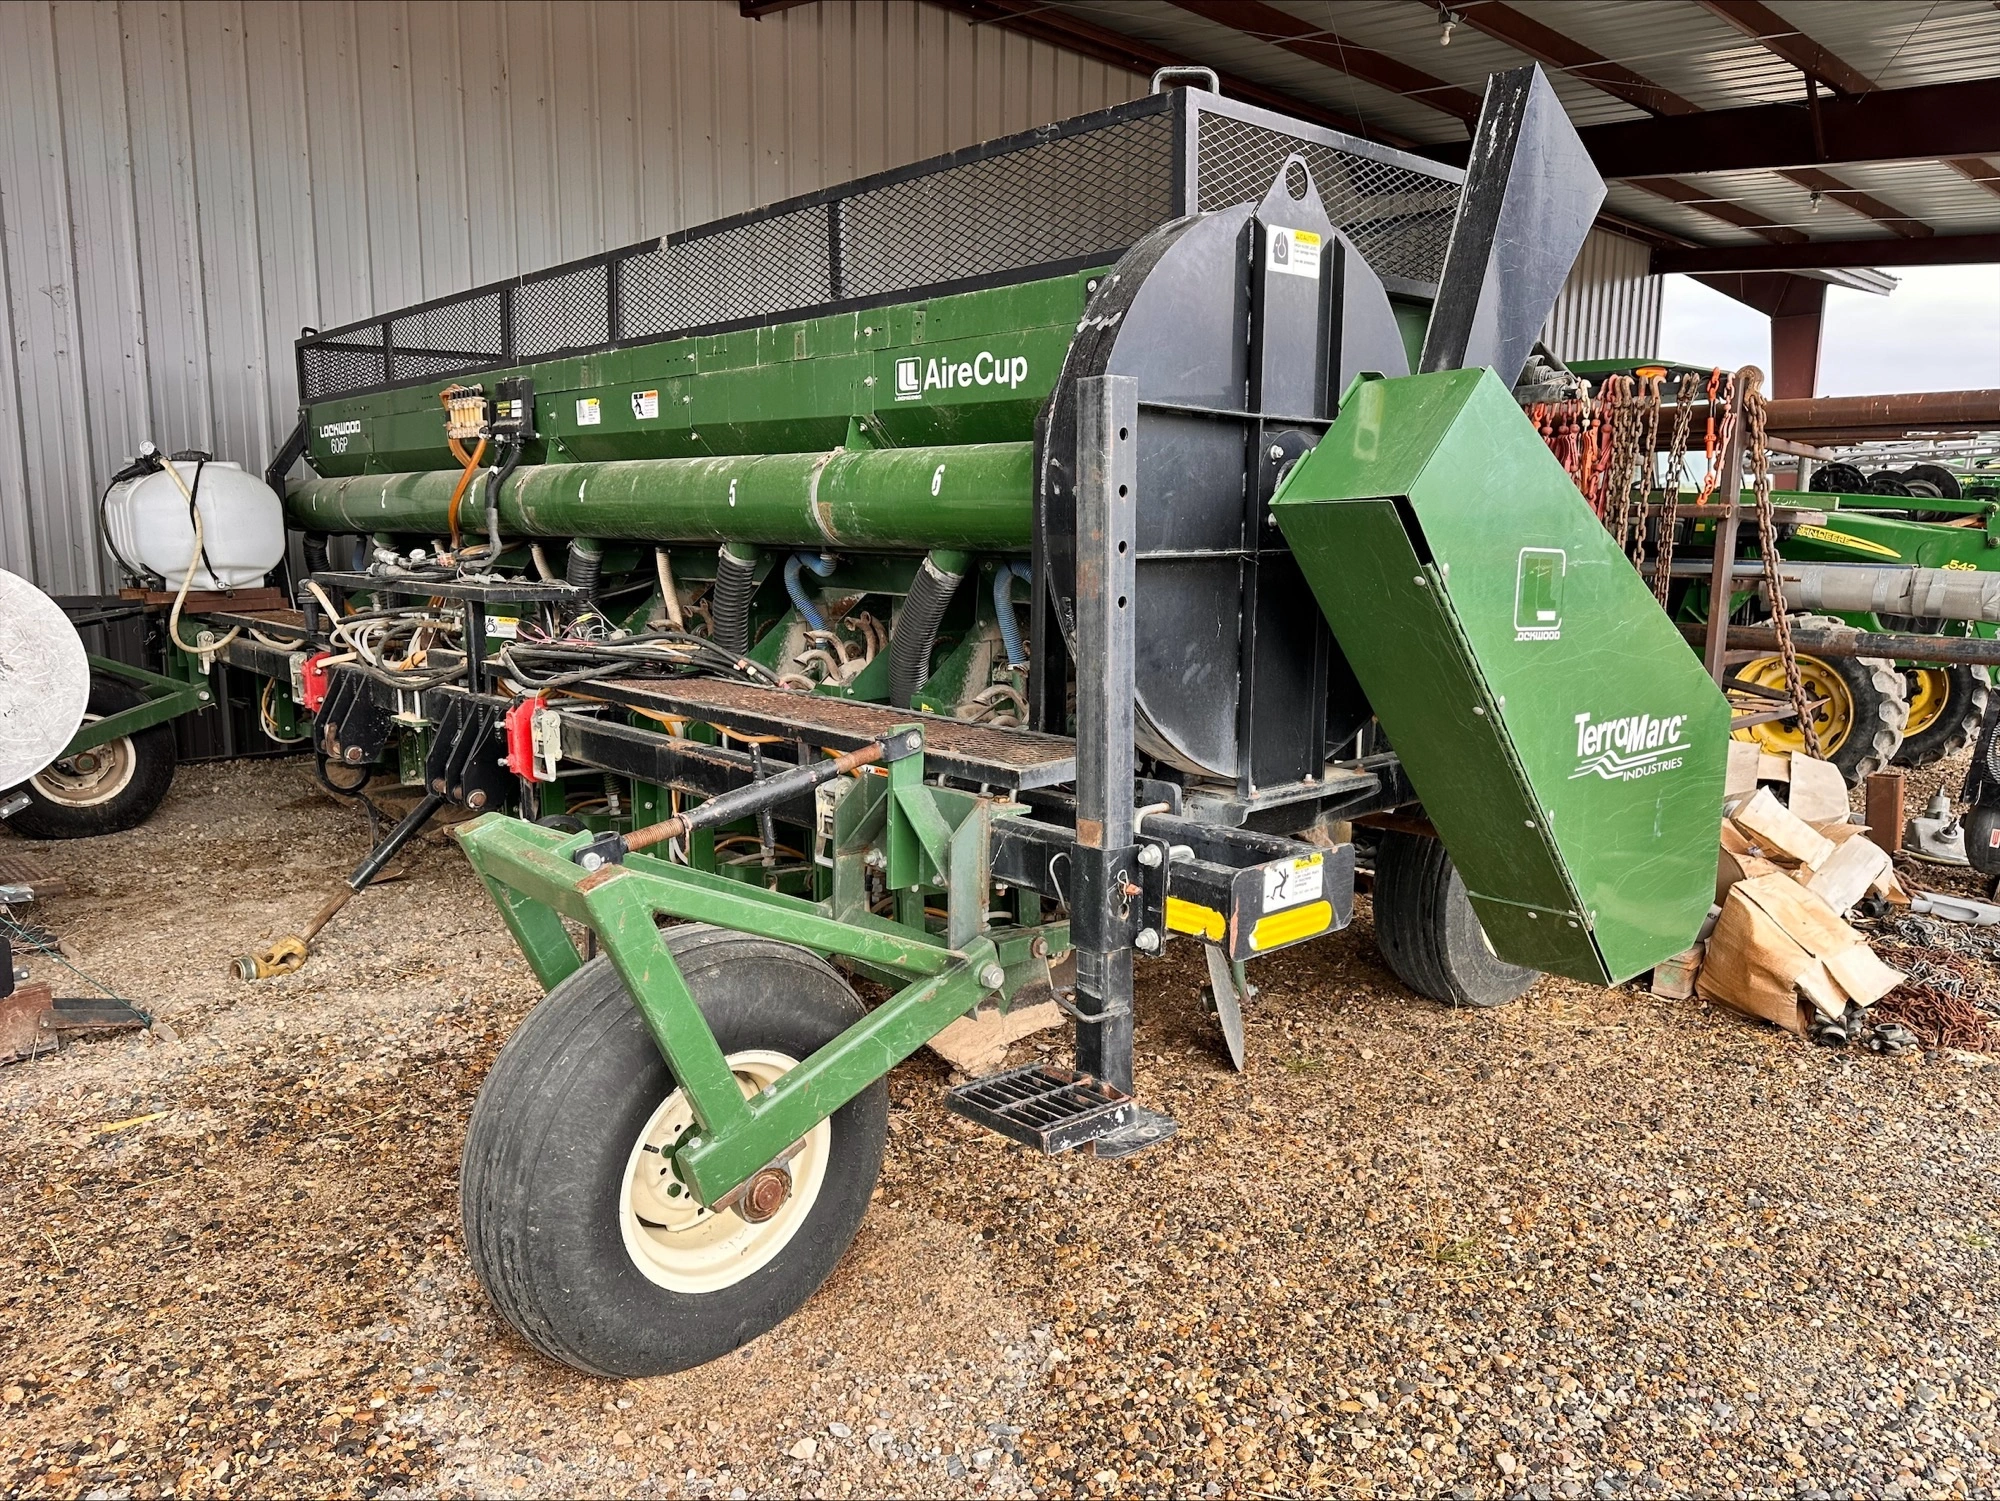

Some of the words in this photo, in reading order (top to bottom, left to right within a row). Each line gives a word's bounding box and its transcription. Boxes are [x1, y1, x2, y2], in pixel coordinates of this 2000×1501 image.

[923, 351, 1028, 390] AireCup
[319, 420, 361, 439] LOCKWOOD
[330, 436, 349, 454] 606P
[578, 478, 588, 503] 4
[931, 463, 946, 497] 6
[728, 478, 738, 508] 5
[1950, 559, 1977, 571] 542
[1575, 712, 1682, 757] TerraMarc
[1622, 757, 1683, 782] INDUSTRIES
